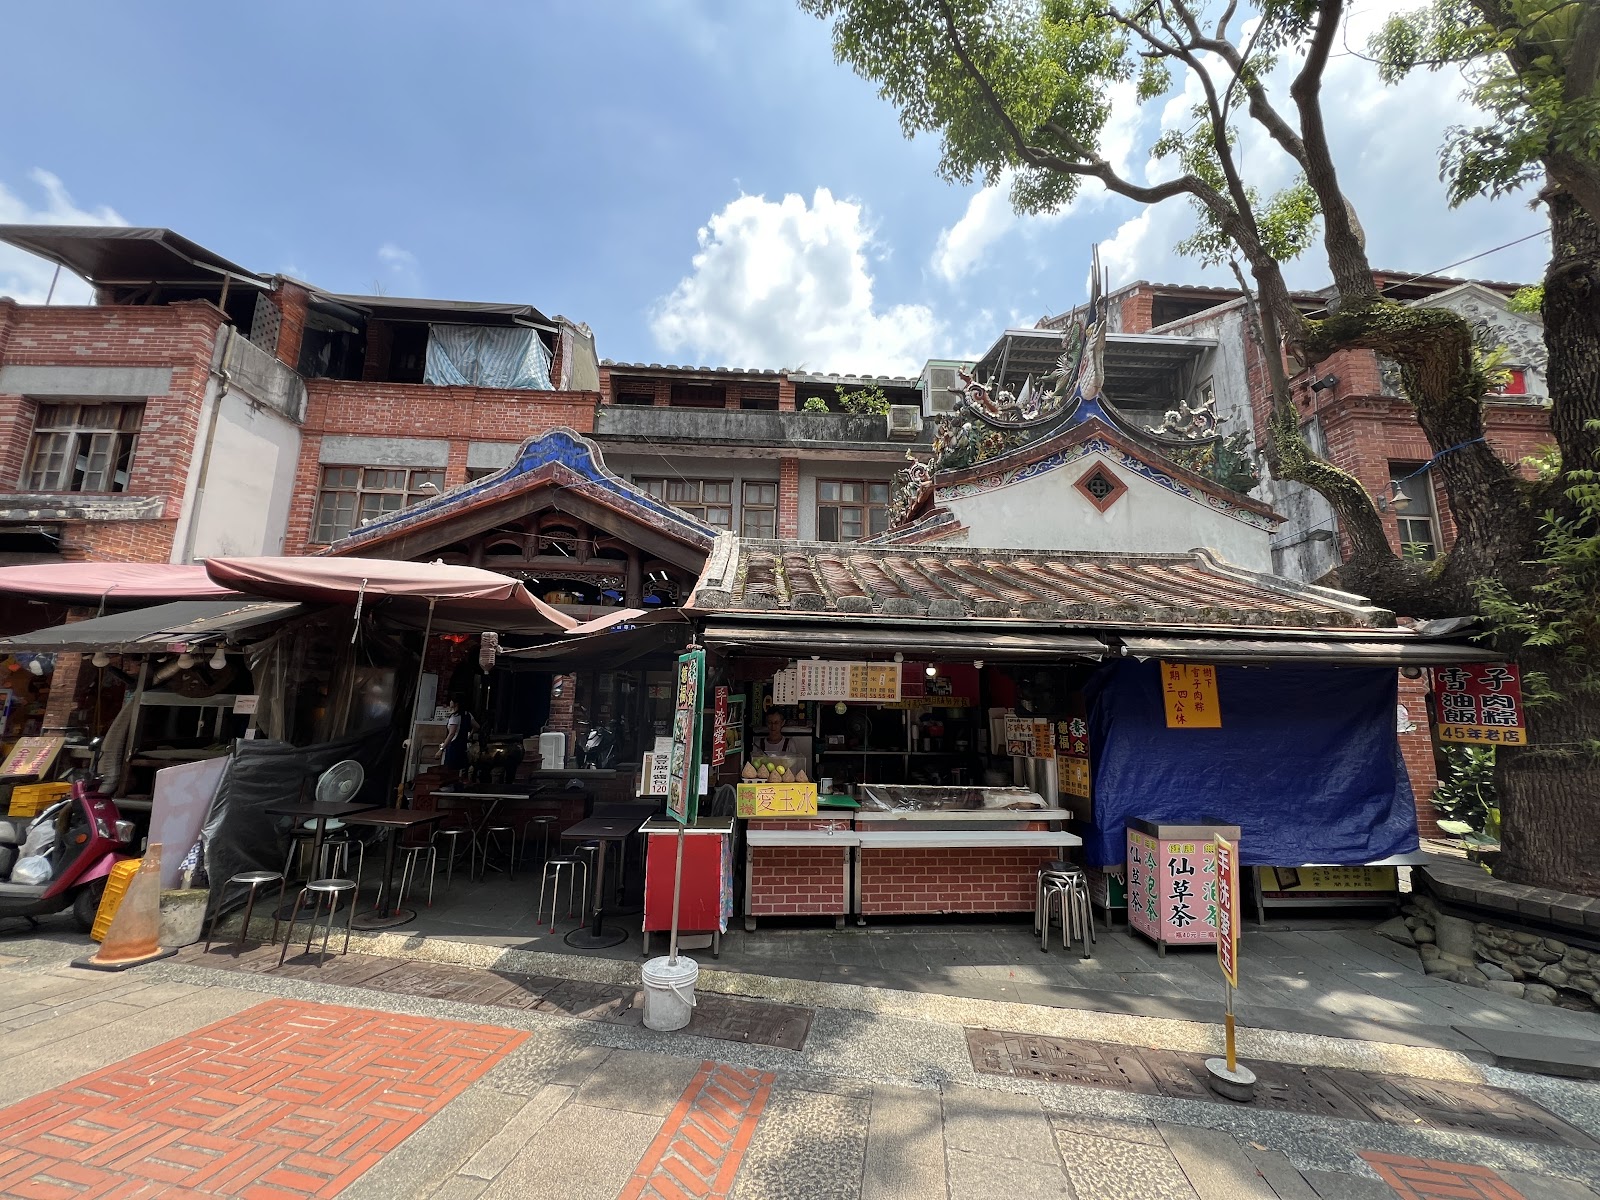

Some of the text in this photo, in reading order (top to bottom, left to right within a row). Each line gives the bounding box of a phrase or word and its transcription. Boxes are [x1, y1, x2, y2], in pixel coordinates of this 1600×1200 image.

[713, 687, 728, 761] 手洗愛玉
[1057, 720, 1070, 750] 德福
[1442, 727, 1520, 742] 45年老店
[652, 785, 667, 793] 120
[756, 786, 815, 813] 愛玉冰
[1129, 846, 1143, 912] 仙草茶
[1144, 852, 1159, 921] 冷泡茶
[1167, 857, 1198, 928] 仙草茶
[1217, 848, 1233, 974] 手洗愛玉
